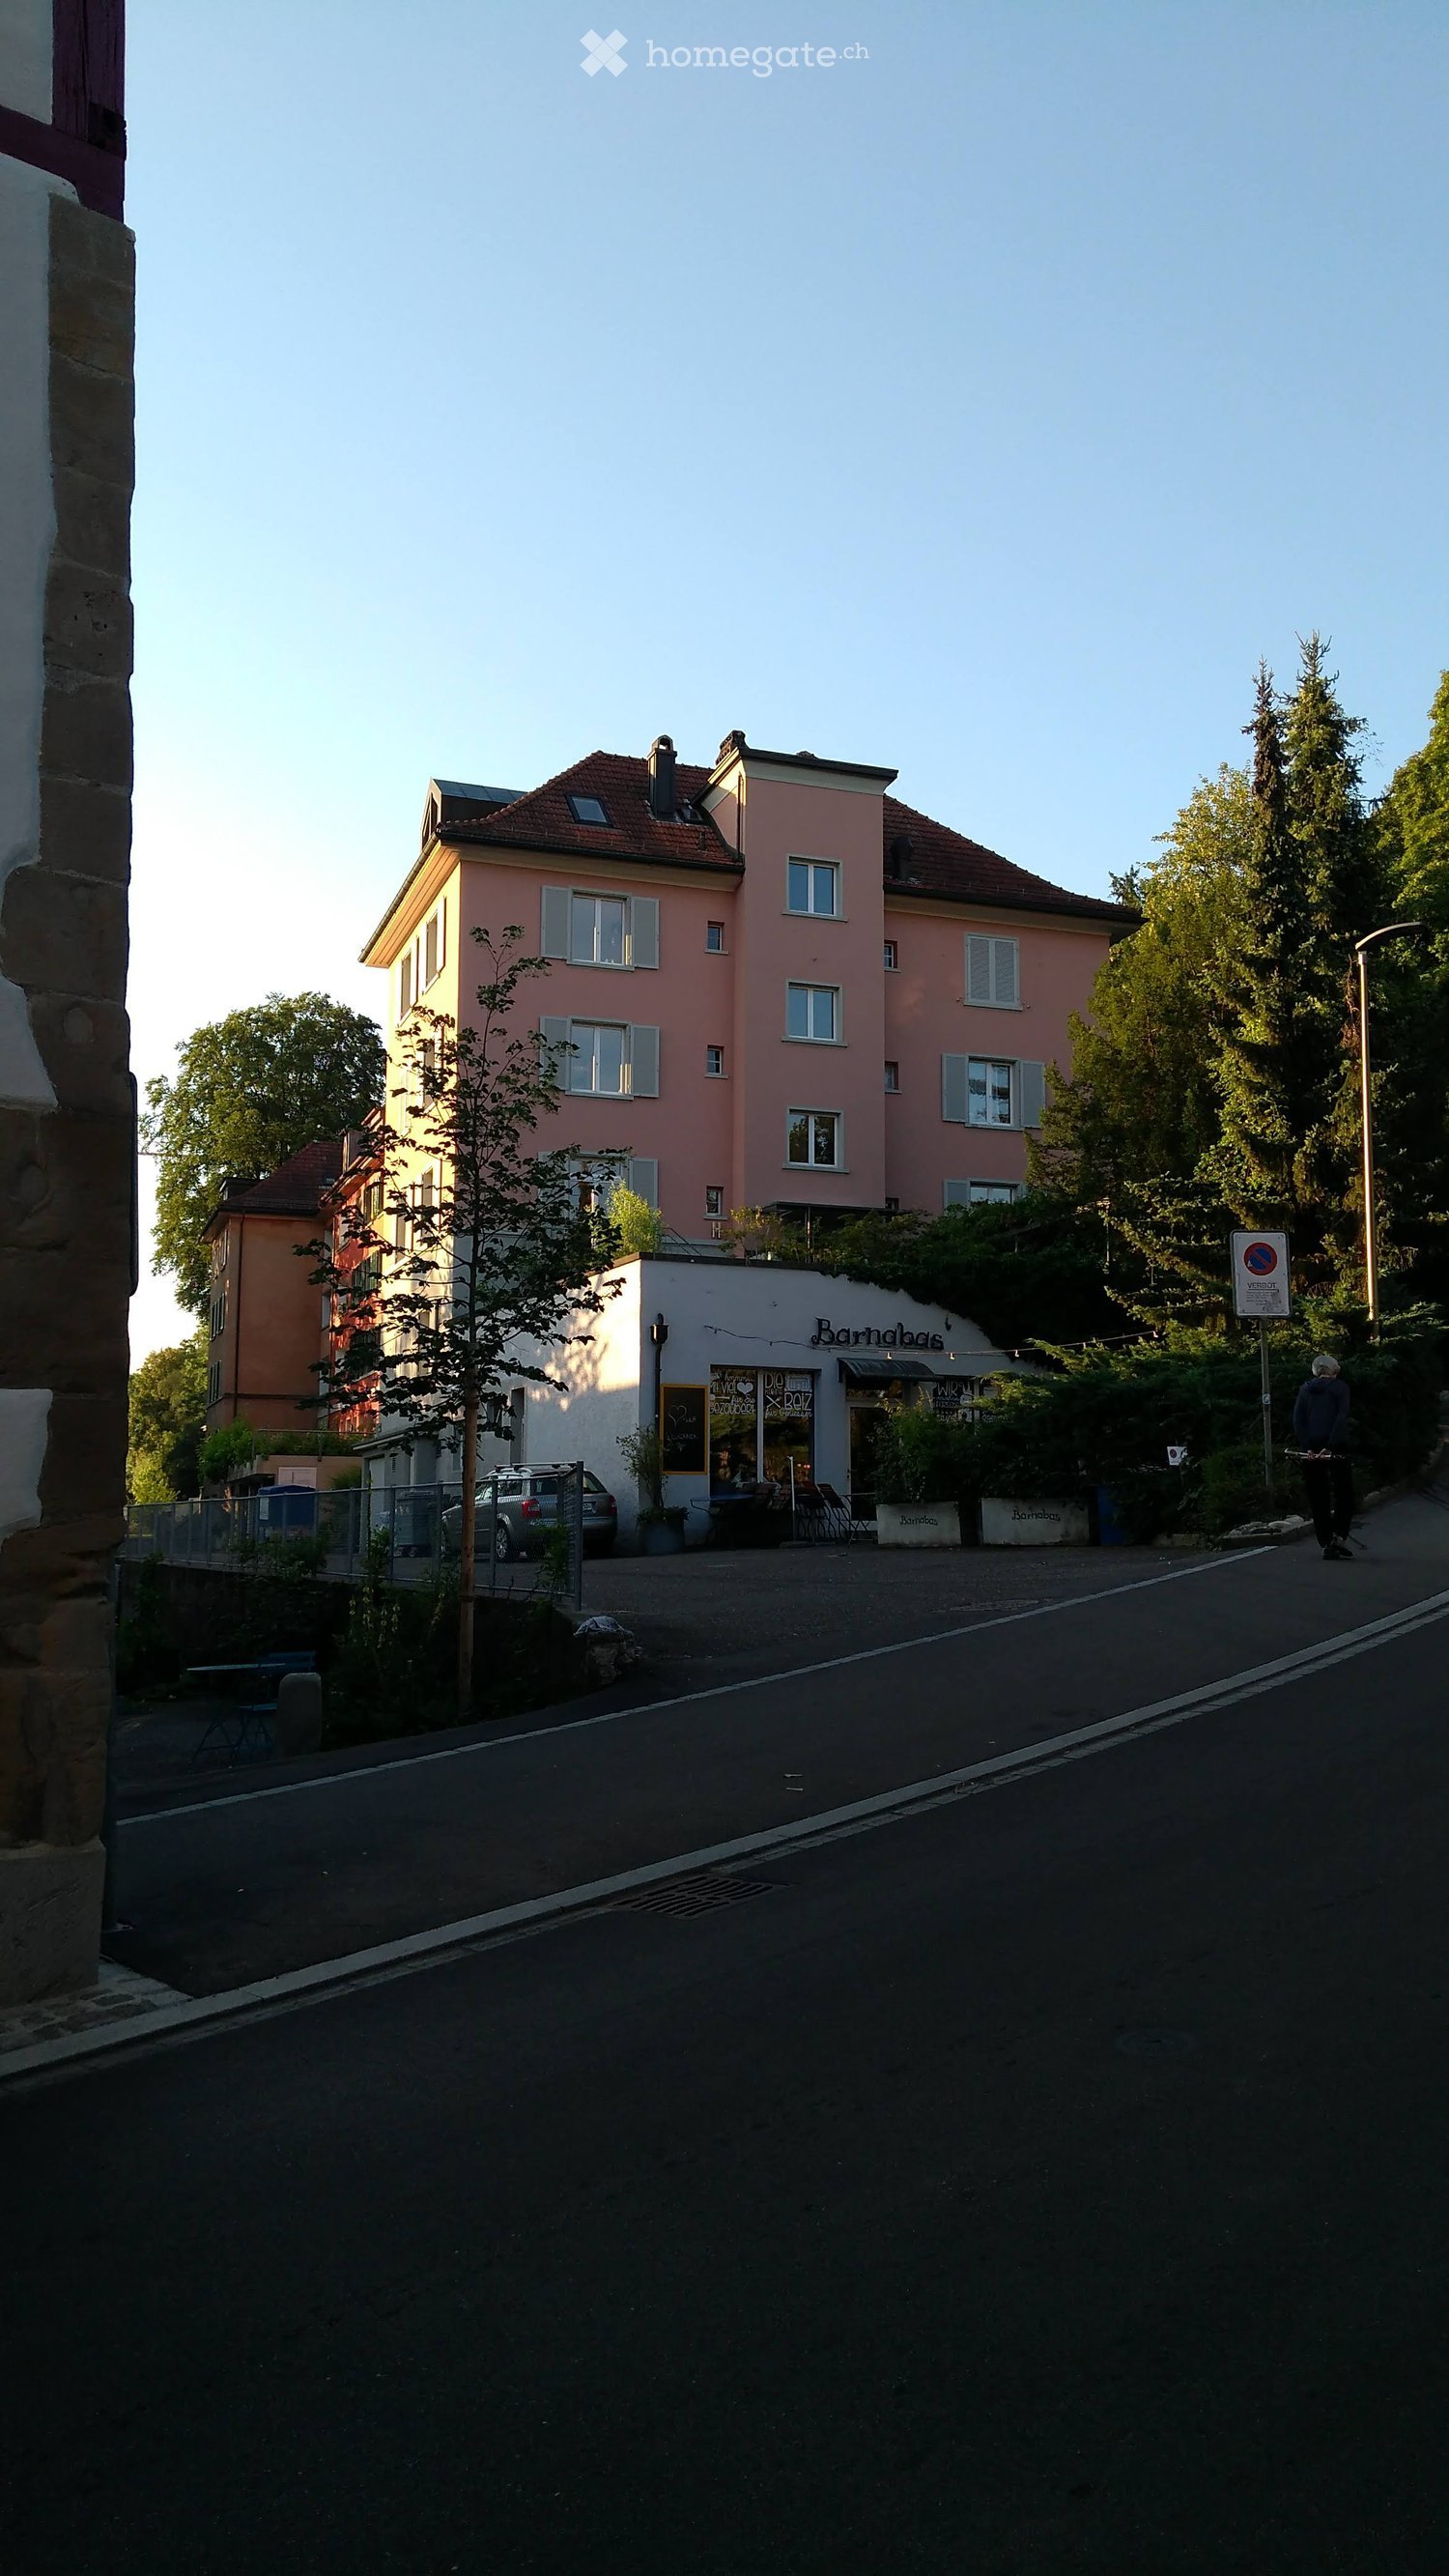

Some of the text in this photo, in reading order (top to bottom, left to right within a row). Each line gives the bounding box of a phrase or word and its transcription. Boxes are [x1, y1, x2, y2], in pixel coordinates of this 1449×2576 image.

[810, 1317, 945, 1351] Barnabas
[899, 1515, 939, 1526] Barnabas
[1011, 1509, 1061, 1522] Barnabas
